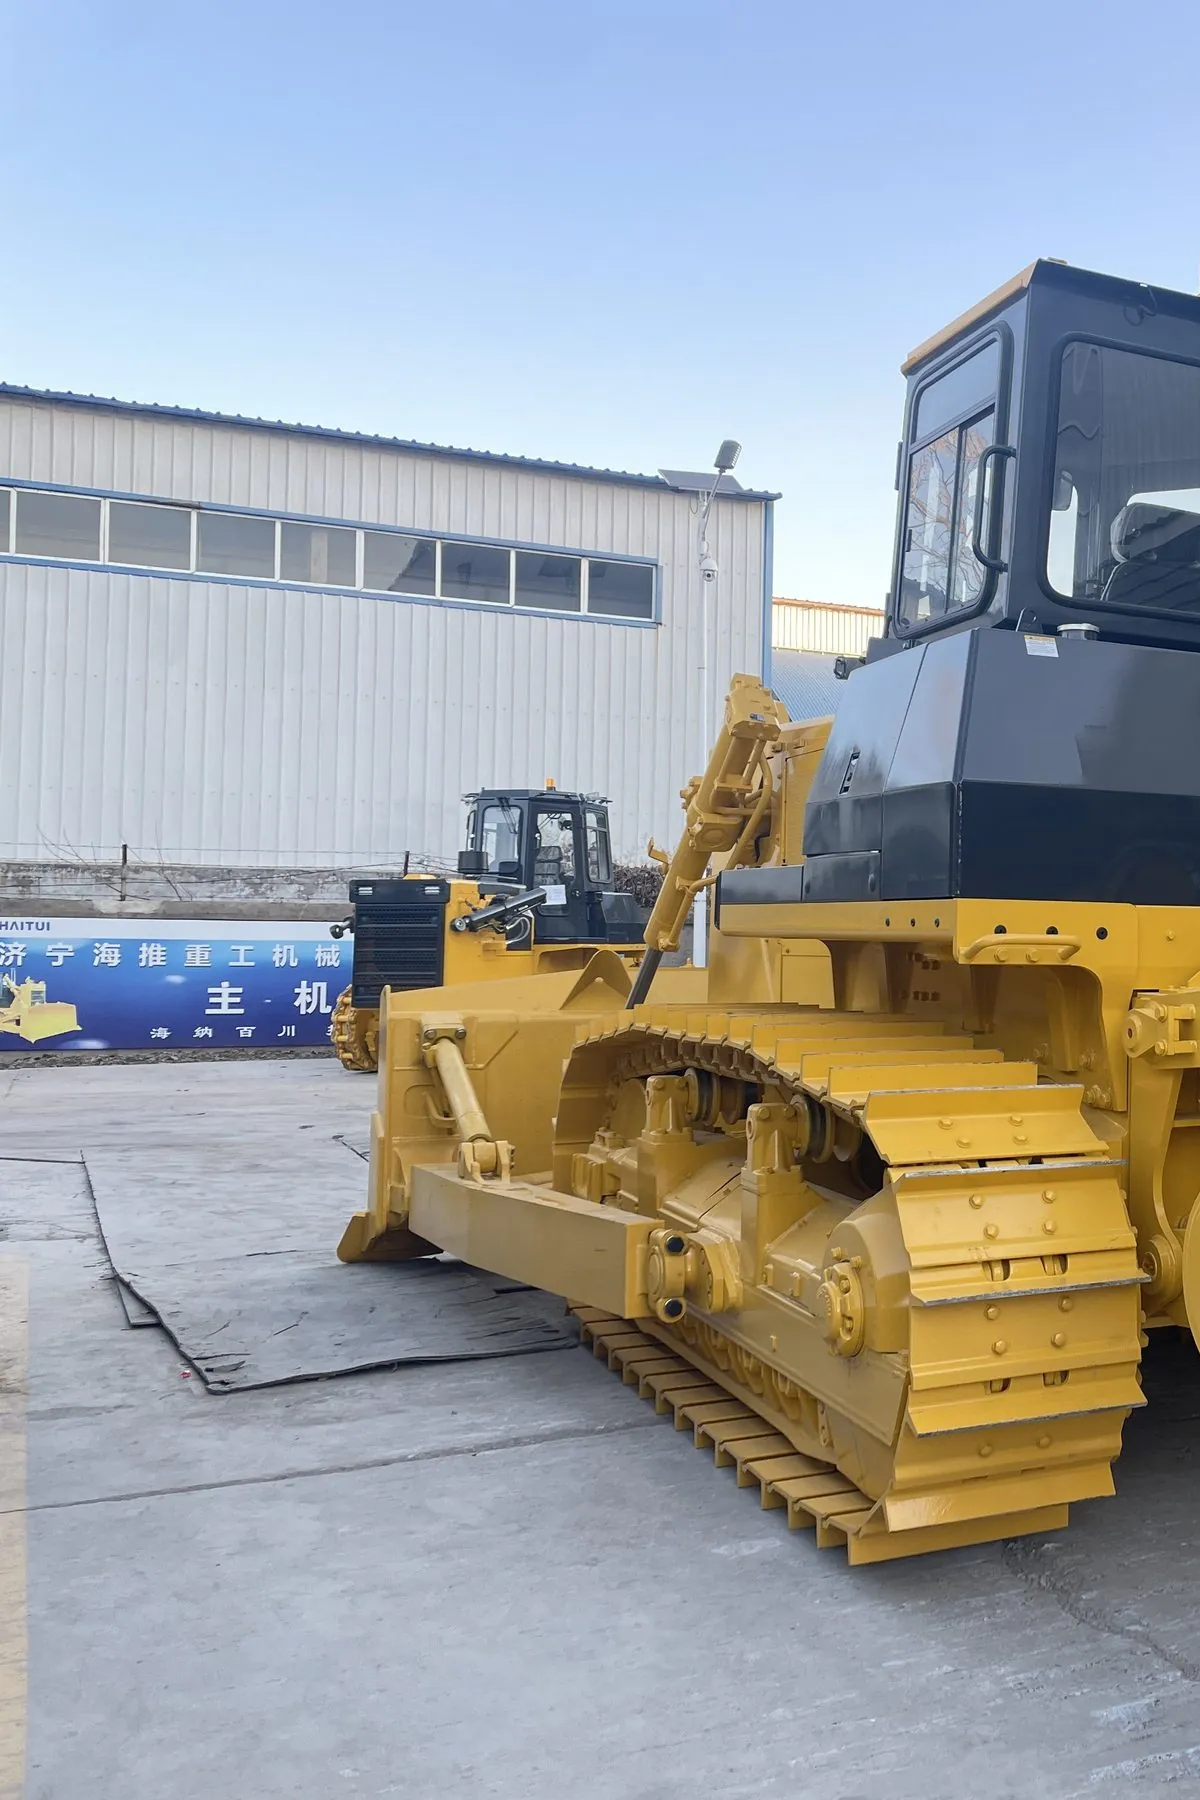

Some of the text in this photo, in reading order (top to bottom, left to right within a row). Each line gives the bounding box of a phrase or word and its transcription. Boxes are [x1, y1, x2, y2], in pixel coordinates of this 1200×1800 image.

[0, 921, 50, 931] HAITUI
[0, 941, 341, 968] 济宁海推重工机械
